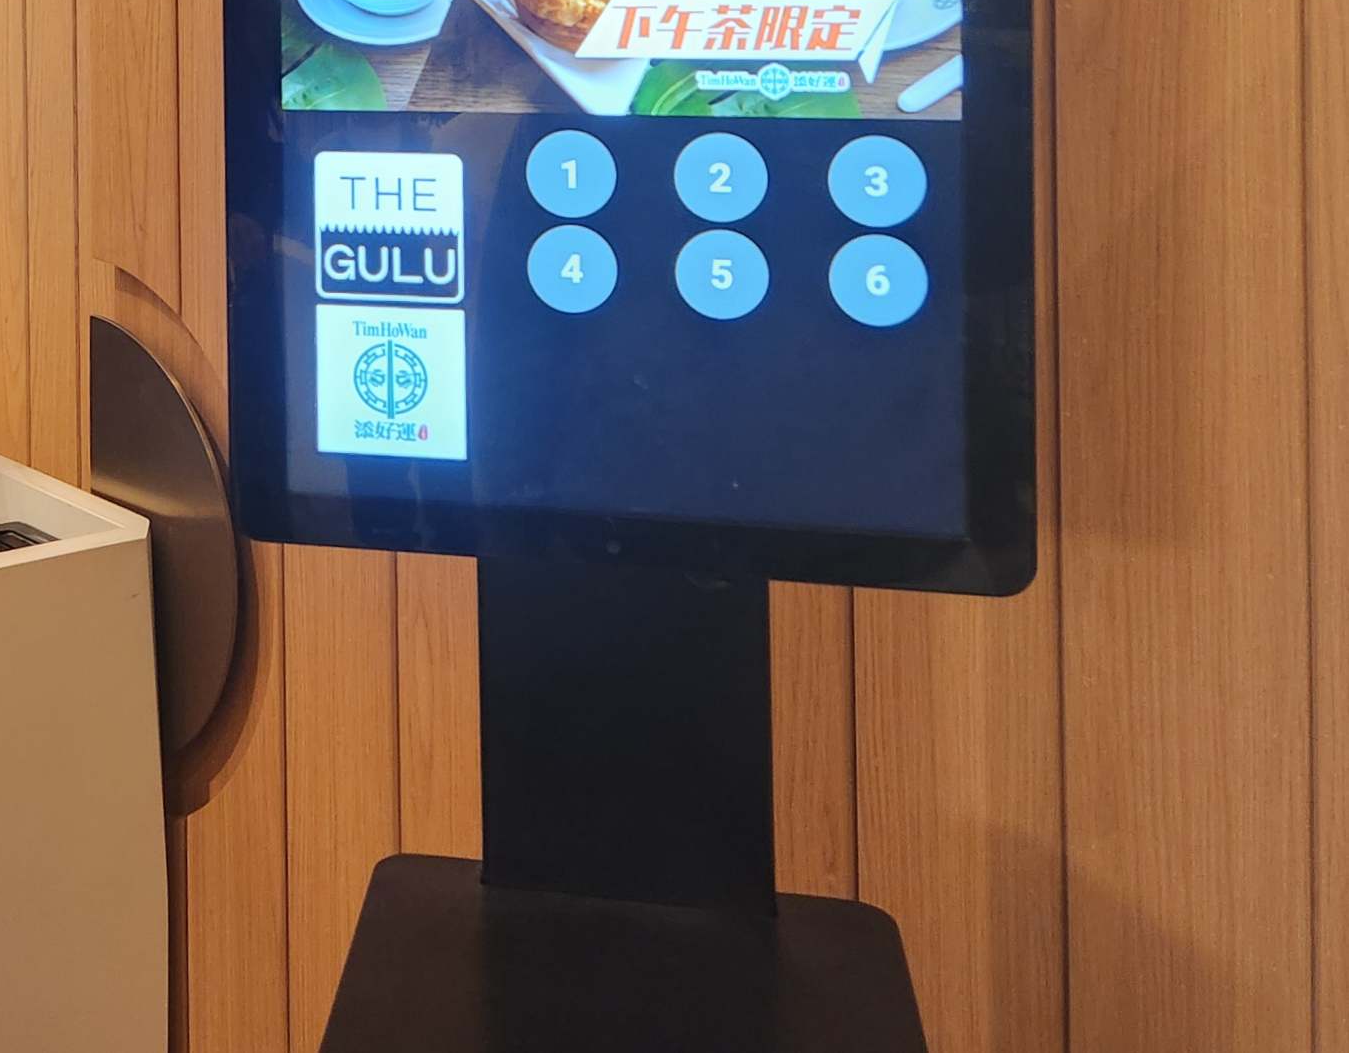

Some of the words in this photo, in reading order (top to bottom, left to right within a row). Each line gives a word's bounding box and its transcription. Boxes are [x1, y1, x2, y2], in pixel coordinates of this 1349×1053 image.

[613, 4, 861, 52] 下午茶限定
[700, 74, 757, 86] TimHoWan
[561, 160, 577, 188] 1
[709, 163, 732, 194] 2
[864, 165, 889, 197] 3
[340, 176, 437, 212] THE
[324, 243, 456, 285] GULU
[560, 255, 584, 283] 4
[710, 259, 733, 290] 5
[865, 265, 890, 296] 6
[352, 321, 427, 339] TimHoWan
[354, 419, 417, 442] 添好運
